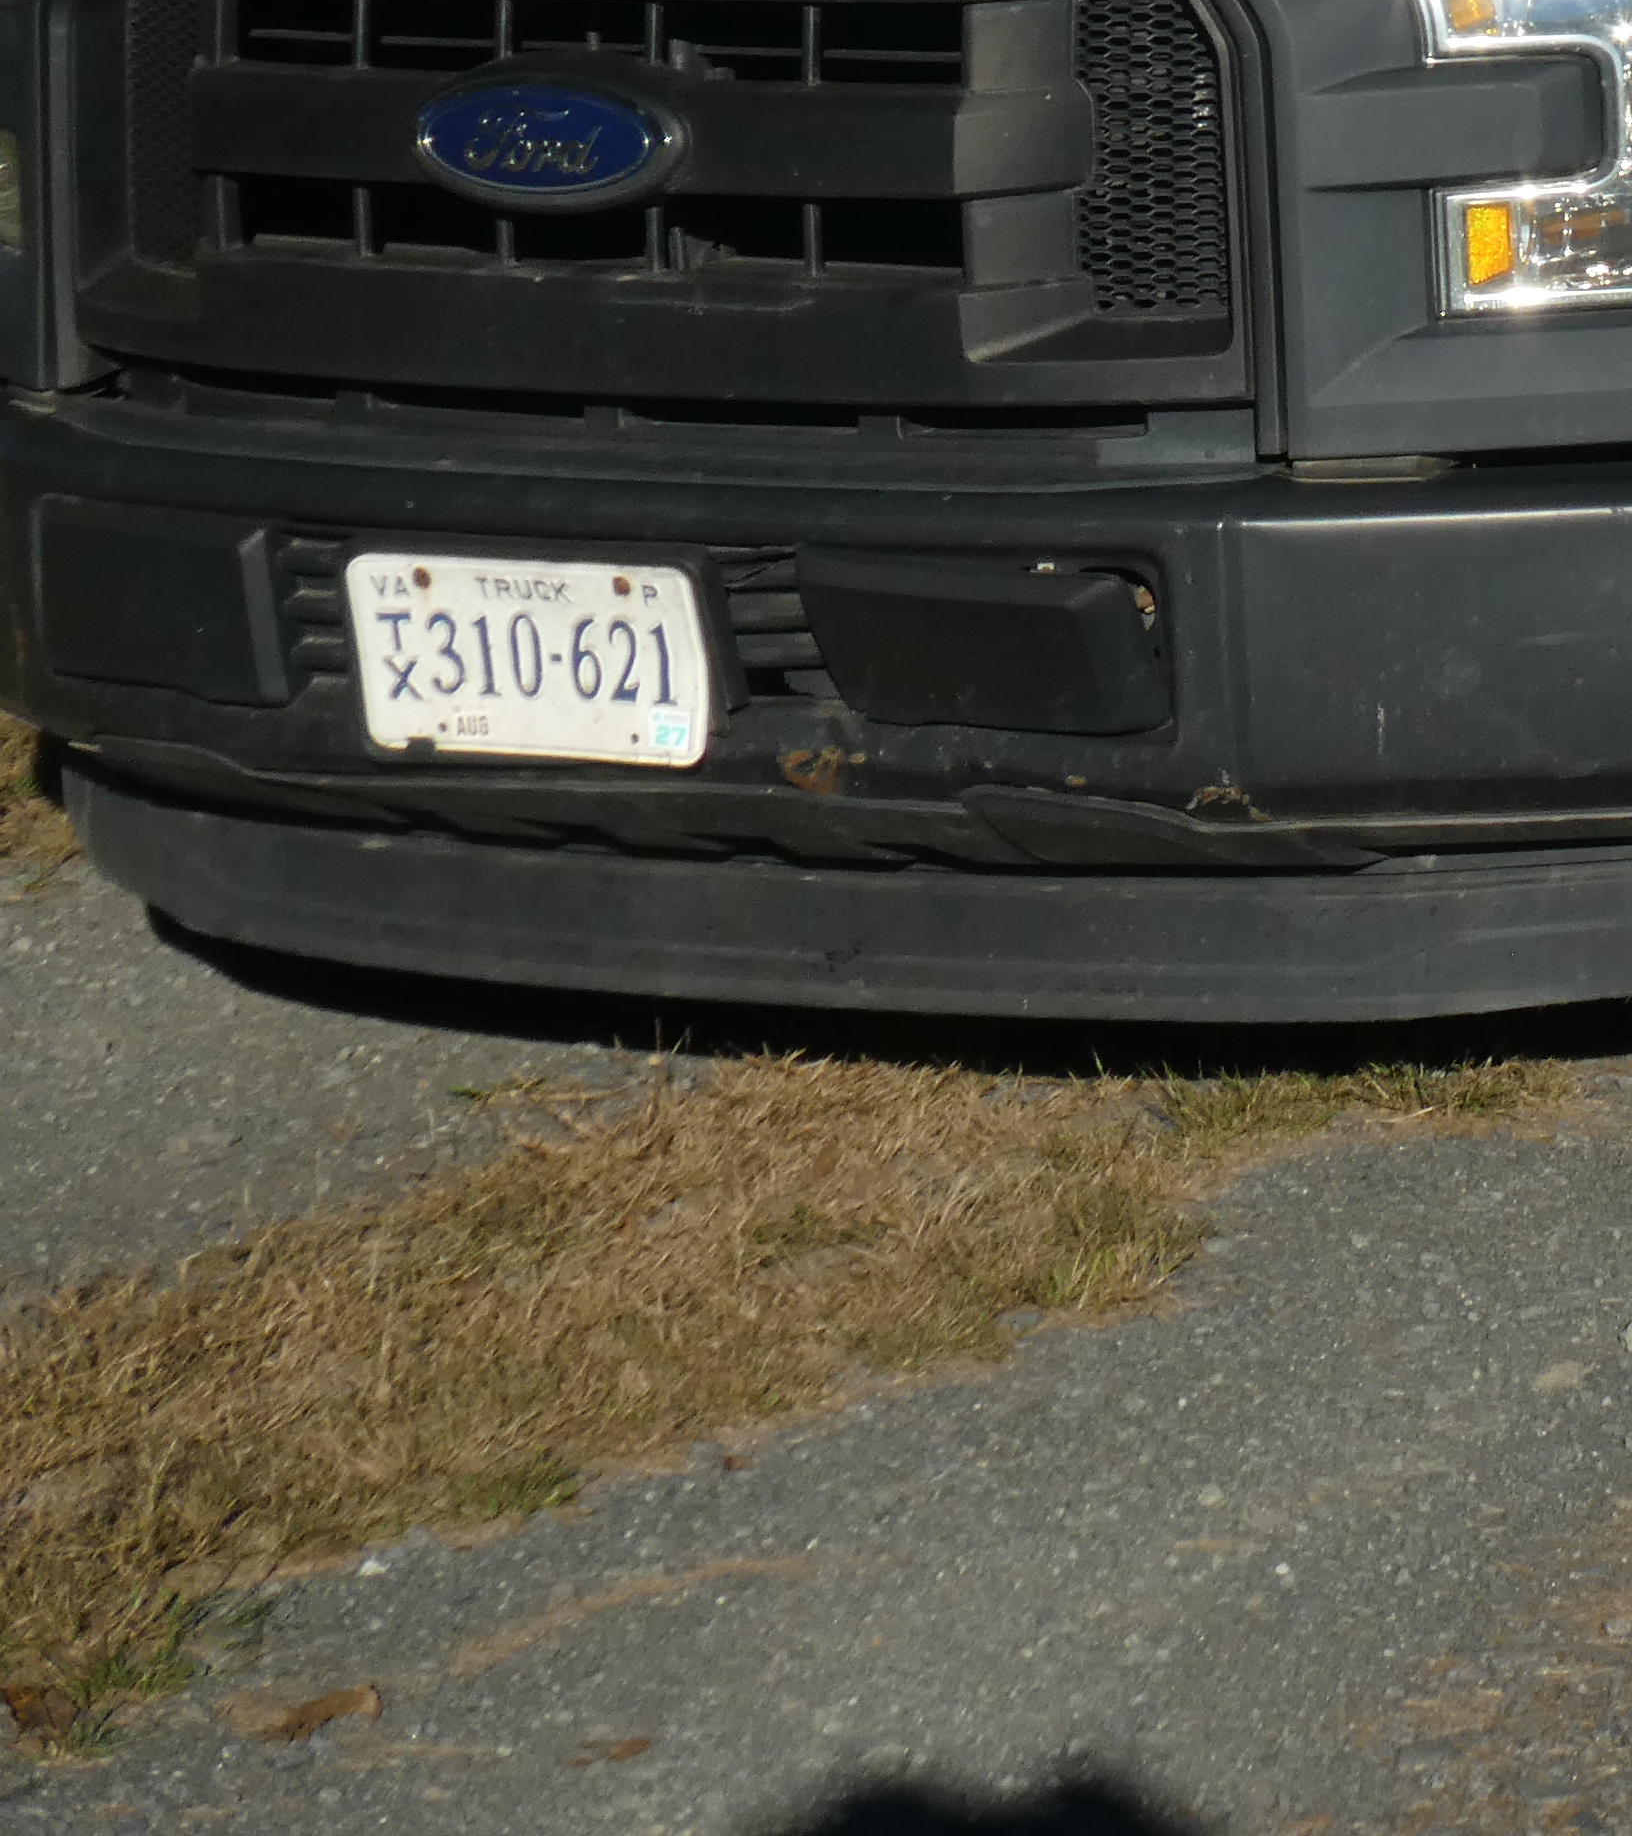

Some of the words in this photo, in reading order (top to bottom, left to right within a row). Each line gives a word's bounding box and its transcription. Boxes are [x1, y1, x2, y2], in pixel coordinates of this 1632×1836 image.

[463, 102, 603, 175] Ford
[370, 574, 411, 598] VA
[474, 575, 574, 605] TRUCK
[642, 584, 659, 607] P
[455, 713, 490, 737] AUG
[655, 724, 687, 746] 27
